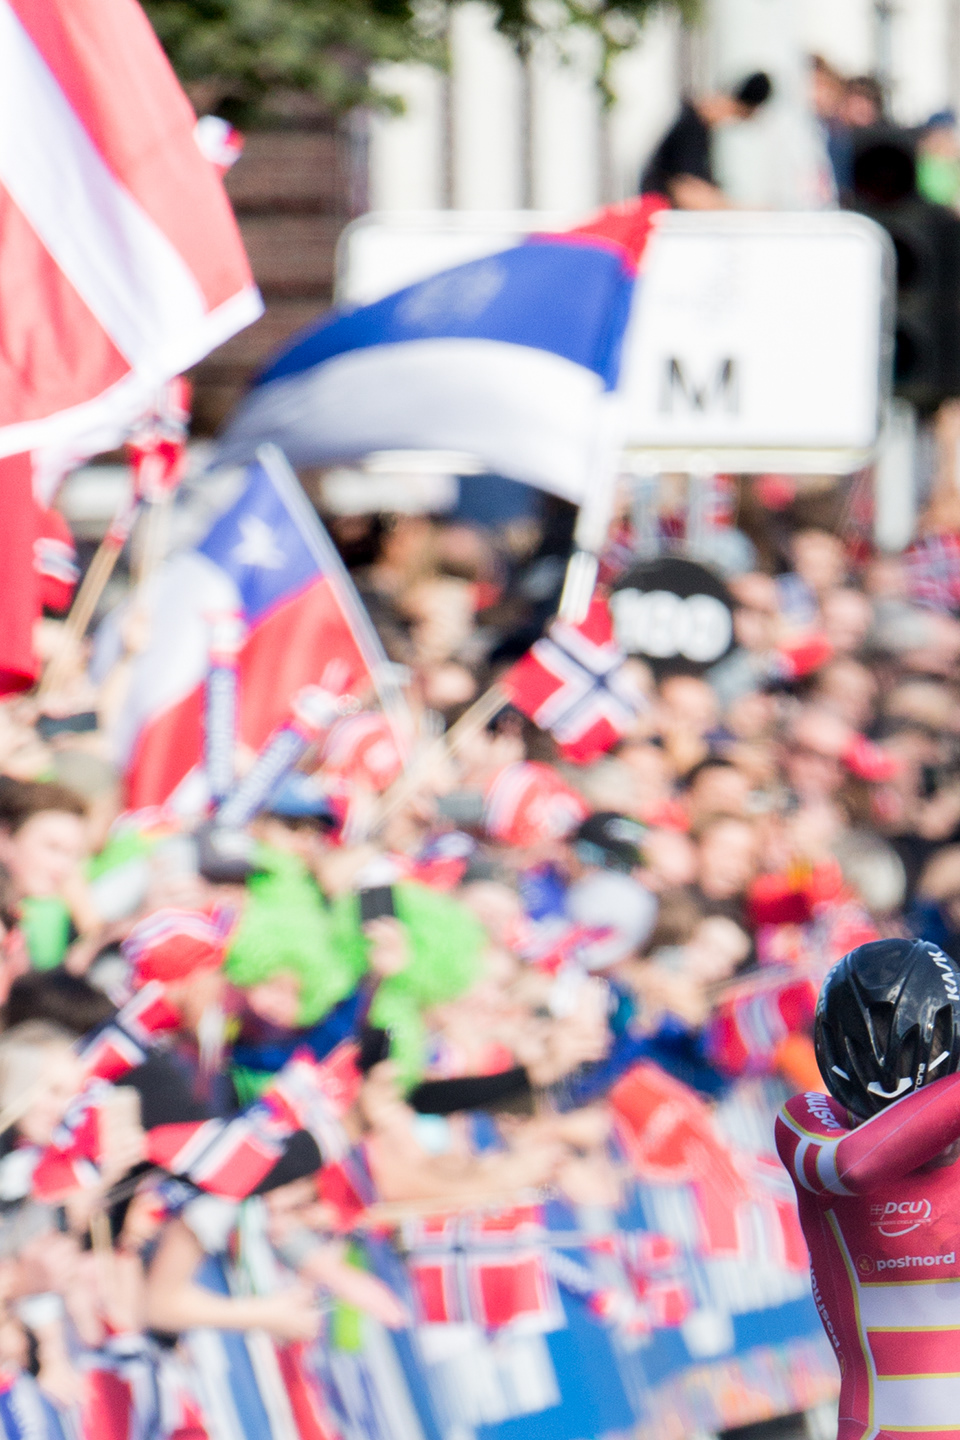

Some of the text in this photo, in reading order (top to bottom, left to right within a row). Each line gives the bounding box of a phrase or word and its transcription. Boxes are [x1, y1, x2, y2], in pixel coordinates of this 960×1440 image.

[659, 354, 742, 417] M
[610, 588, 732, 662] 100
[928, 950, 960, 1001] KASK
[884, 1201, 923, 1214] DCU
[876, 1252, 956, 1271] postnord
